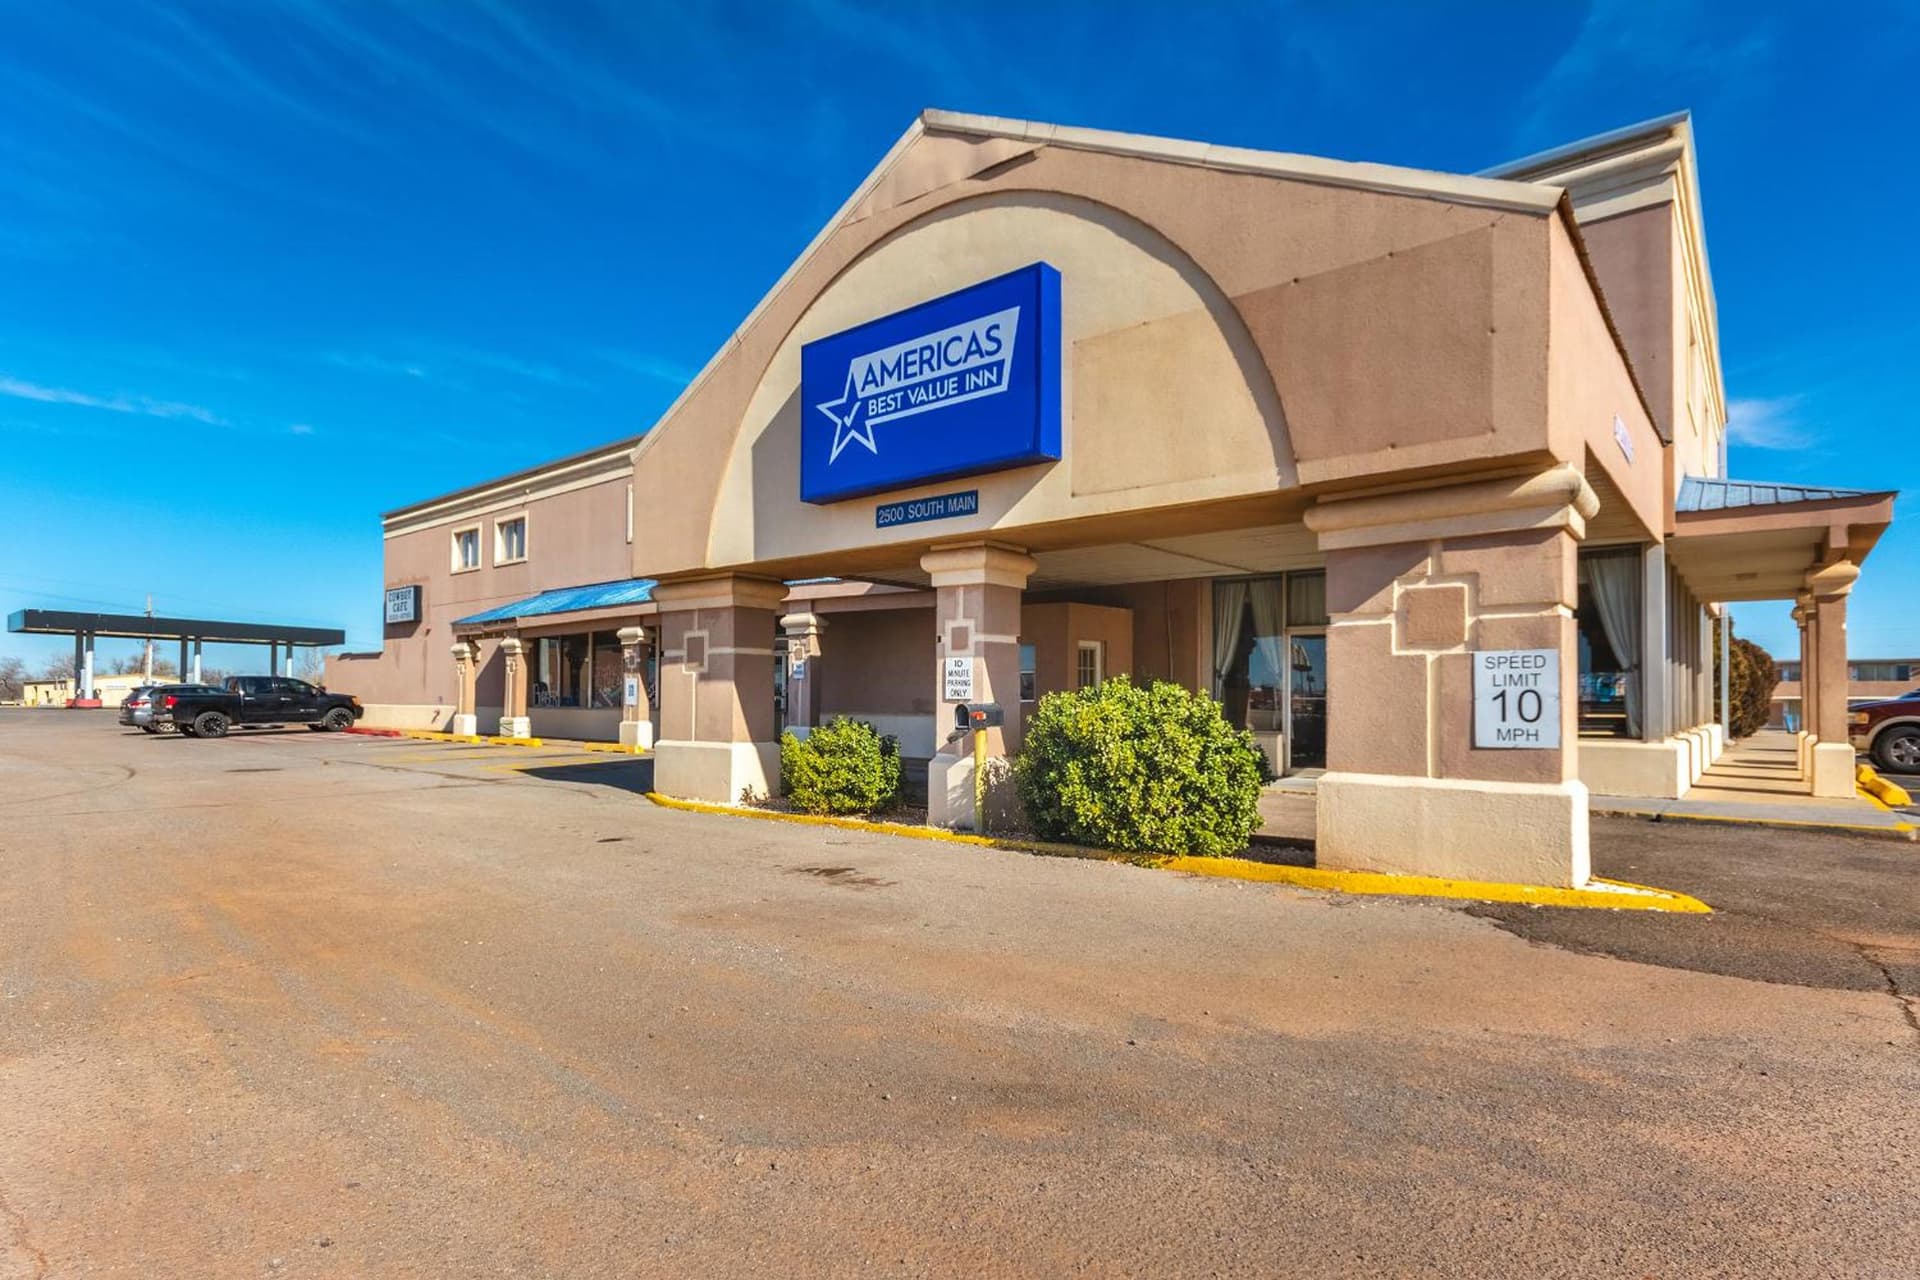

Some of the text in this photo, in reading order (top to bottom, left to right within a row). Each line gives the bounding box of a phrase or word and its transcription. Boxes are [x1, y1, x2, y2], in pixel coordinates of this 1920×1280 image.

[861, 324, 1002, 392] AMERICAS
[868, 366, 998, 416] BEST VALUE INN
[878, 495, 976, 524] 2500 SOUTH MAIN
[393, 601, 408, 613] CAFE
[954, 659, 964, 668] 10
[1484, 654, 1547, 670] SPEED
[947, 669, 970, 678] MINUTE
[1492, 672, 1542, 688] LIMIT
[947, 679, 971, 687] PARKING
[950, 688, 968, 697] ONLY
[1491, 689, 1542, 724] 10
[1496, 727, 1539, 742] MPH
